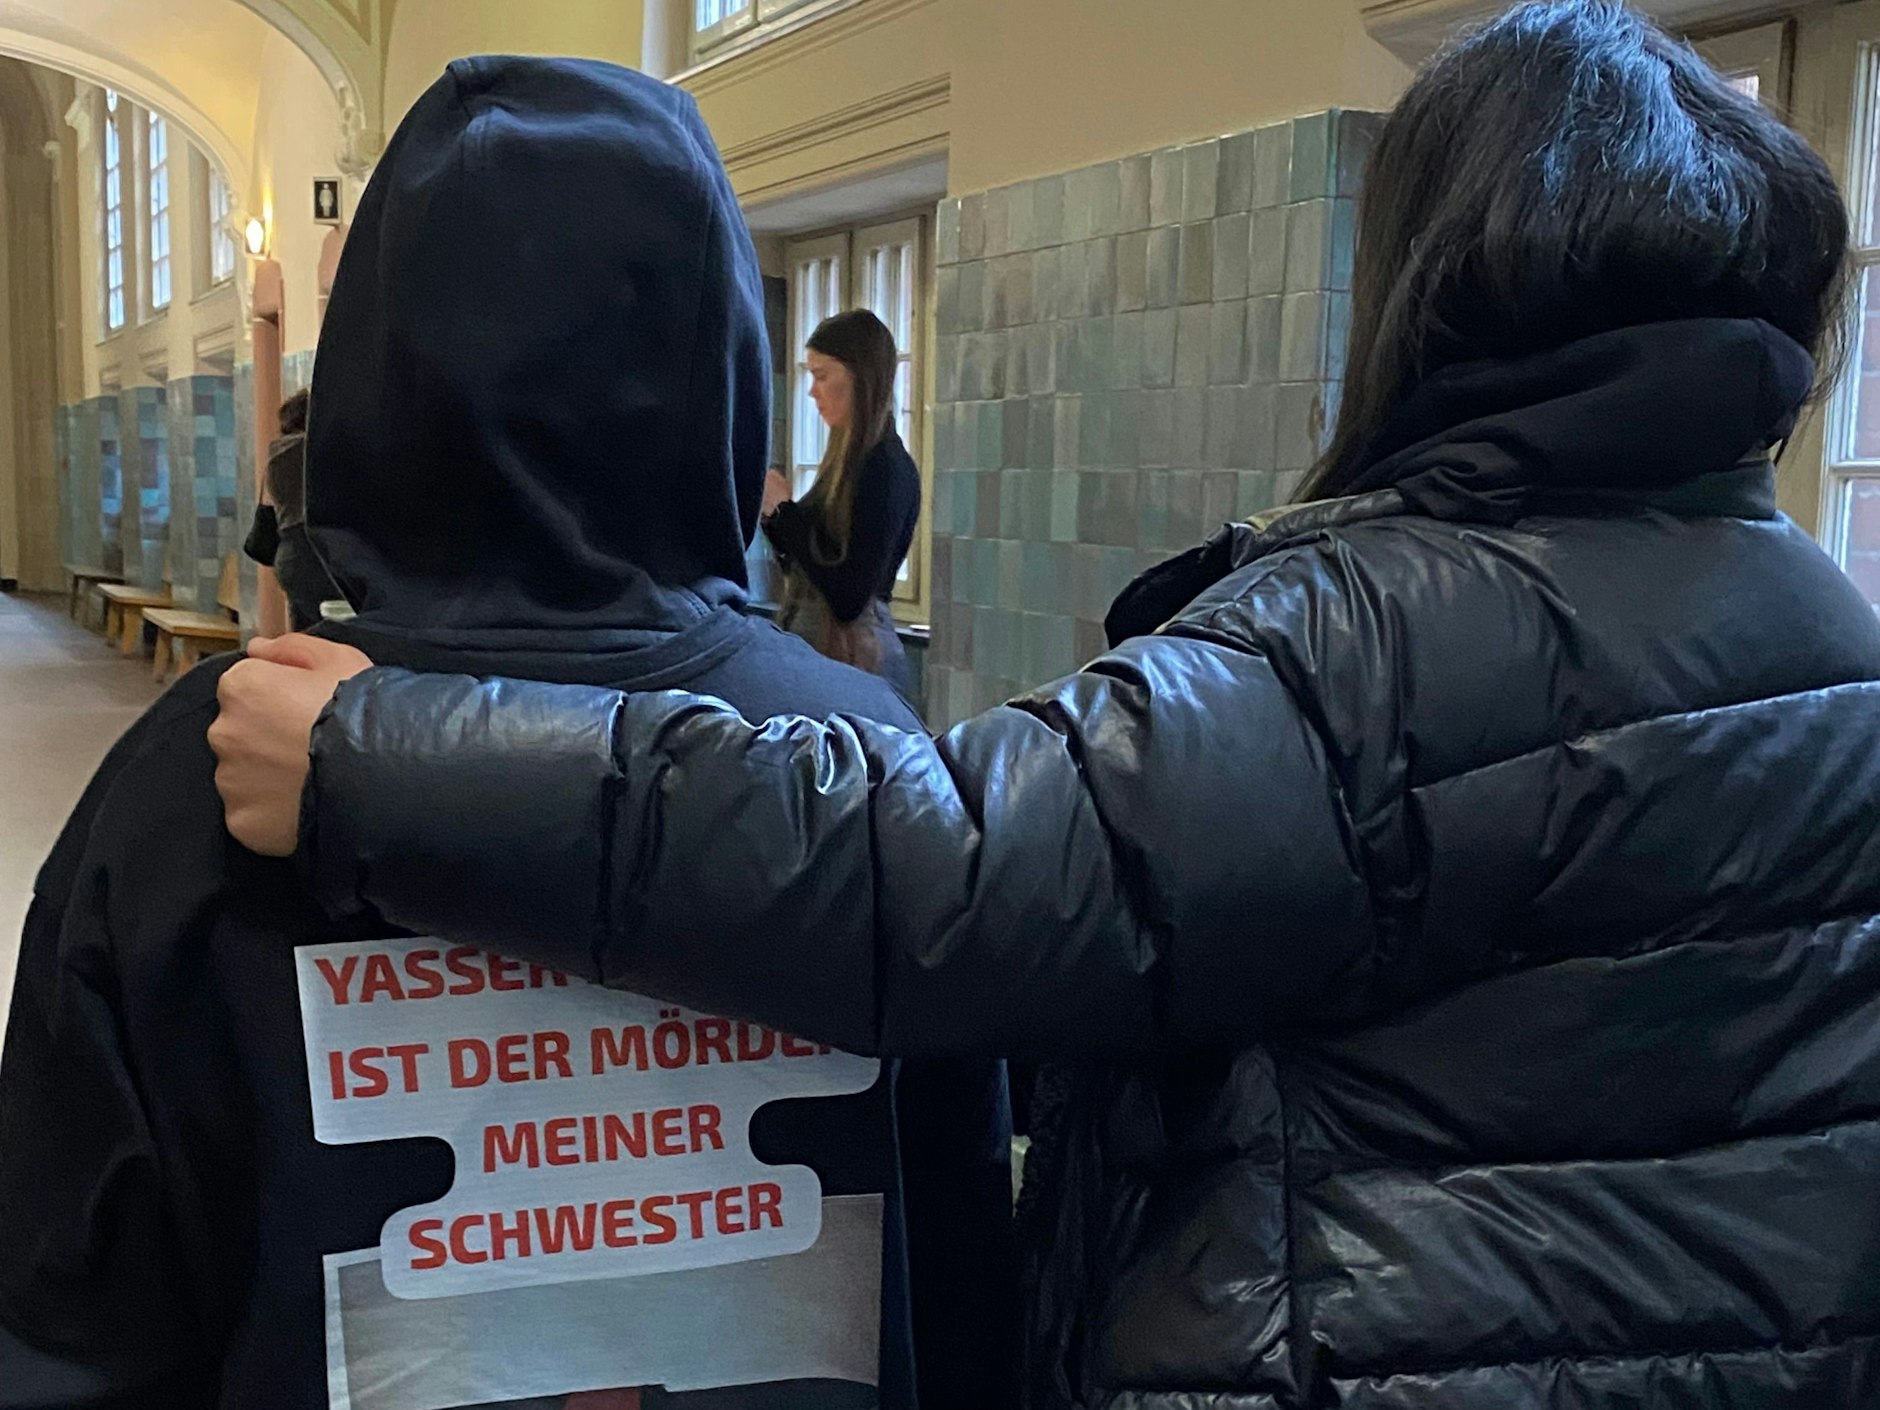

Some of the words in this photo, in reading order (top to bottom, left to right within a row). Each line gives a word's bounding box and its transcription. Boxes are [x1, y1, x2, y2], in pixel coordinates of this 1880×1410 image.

[328, 1043, 429, 1100] IST
[447, 1030, 573, 1089] DER
[590, 1008, 831, 1075] MÖRD
[483, 1104, 725, 1173] MEINER
[408, 1182, 784, 1270] SCHWESTER
